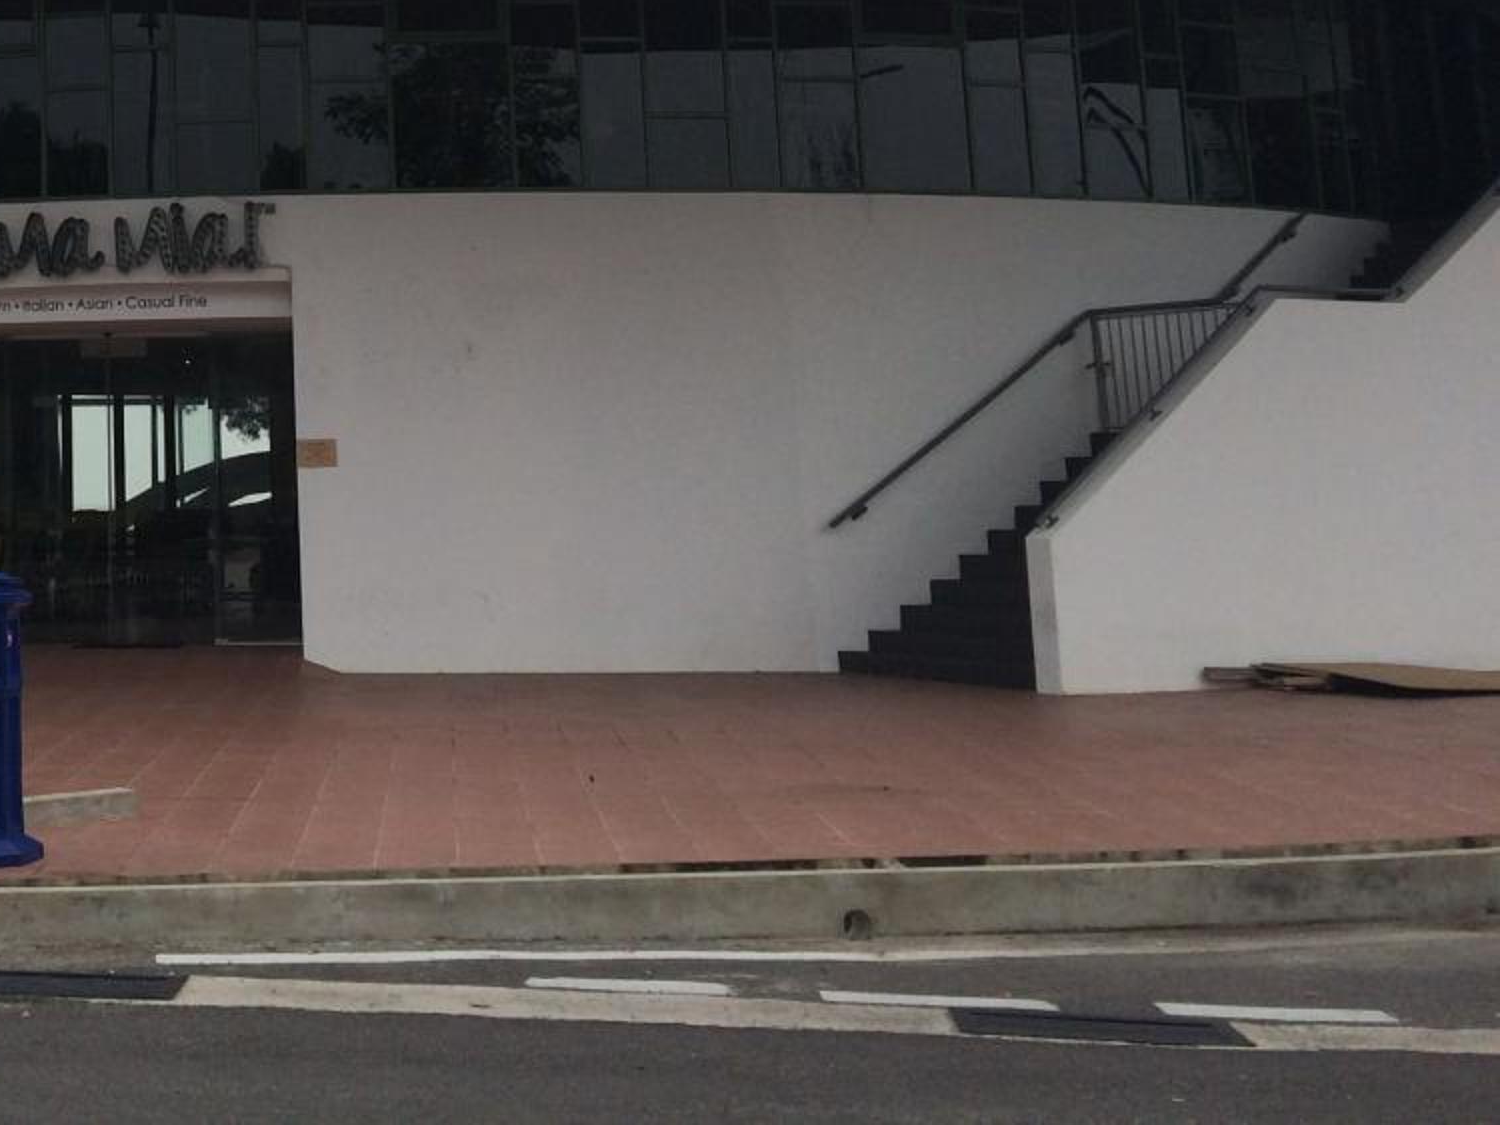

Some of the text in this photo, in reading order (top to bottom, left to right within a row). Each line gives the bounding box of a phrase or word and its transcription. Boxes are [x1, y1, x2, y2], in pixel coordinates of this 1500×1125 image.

[22, 299, 65, 312] Italian
[75, 297, 113, 310] Asian
[125, 294, 176, 309] Casual
[179, 293, 208, 307] Fine
